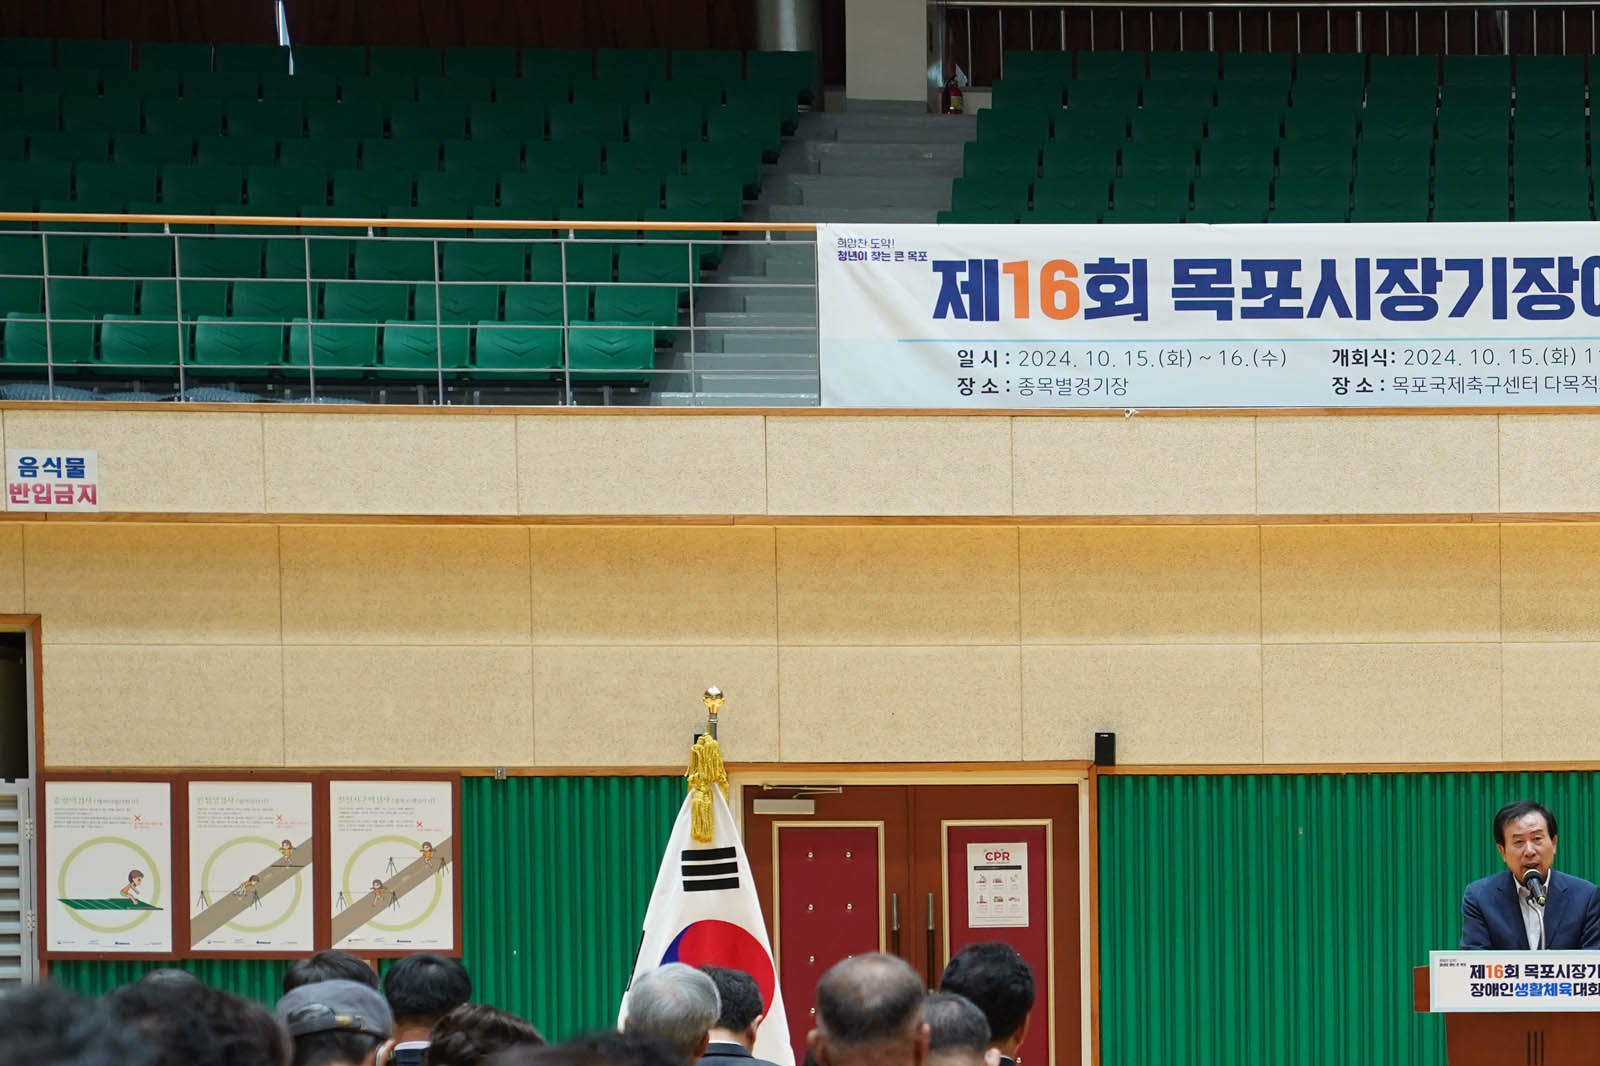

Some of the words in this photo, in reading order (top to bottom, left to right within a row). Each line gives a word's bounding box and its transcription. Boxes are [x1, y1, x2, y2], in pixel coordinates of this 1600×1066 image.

[837, 237, 867, 249] 희망찬
[870, 238, 895, 249] 도약!
[837, 250, 868, 262] 청년이
[871, 250, 892, 262] 찾는
[895, 250, 905, 262] 큰
[908, 250, 929, 262] 목포
[932, 257, 1149, 322] 제16회
[1018, 349, 1077, 368] 2024.
[1085, 350, 1116, 368] 10.
[1124, 348, 1192, 369] 15.(화)
[1218, 348, 1287, 368] 16.(수)
[1331, 347, 1396, 368] 개회식:
[1403, 348, 1462, 367] 2024.
[1470, 348, 1501, 367] 10.
[1508, 346, 1576, 367] 15.(화)
[1017, 376, 1129, 397] 종목별경기장
[1391, 375, 1538, 396] 목포국제축구센터
[18, 456, 85, 479] 음식물
[9, 483, 97, 505] 반입금지
[985, 852, 1010, 861] CPR
[1469, 964, 1519, 979] 제16회
